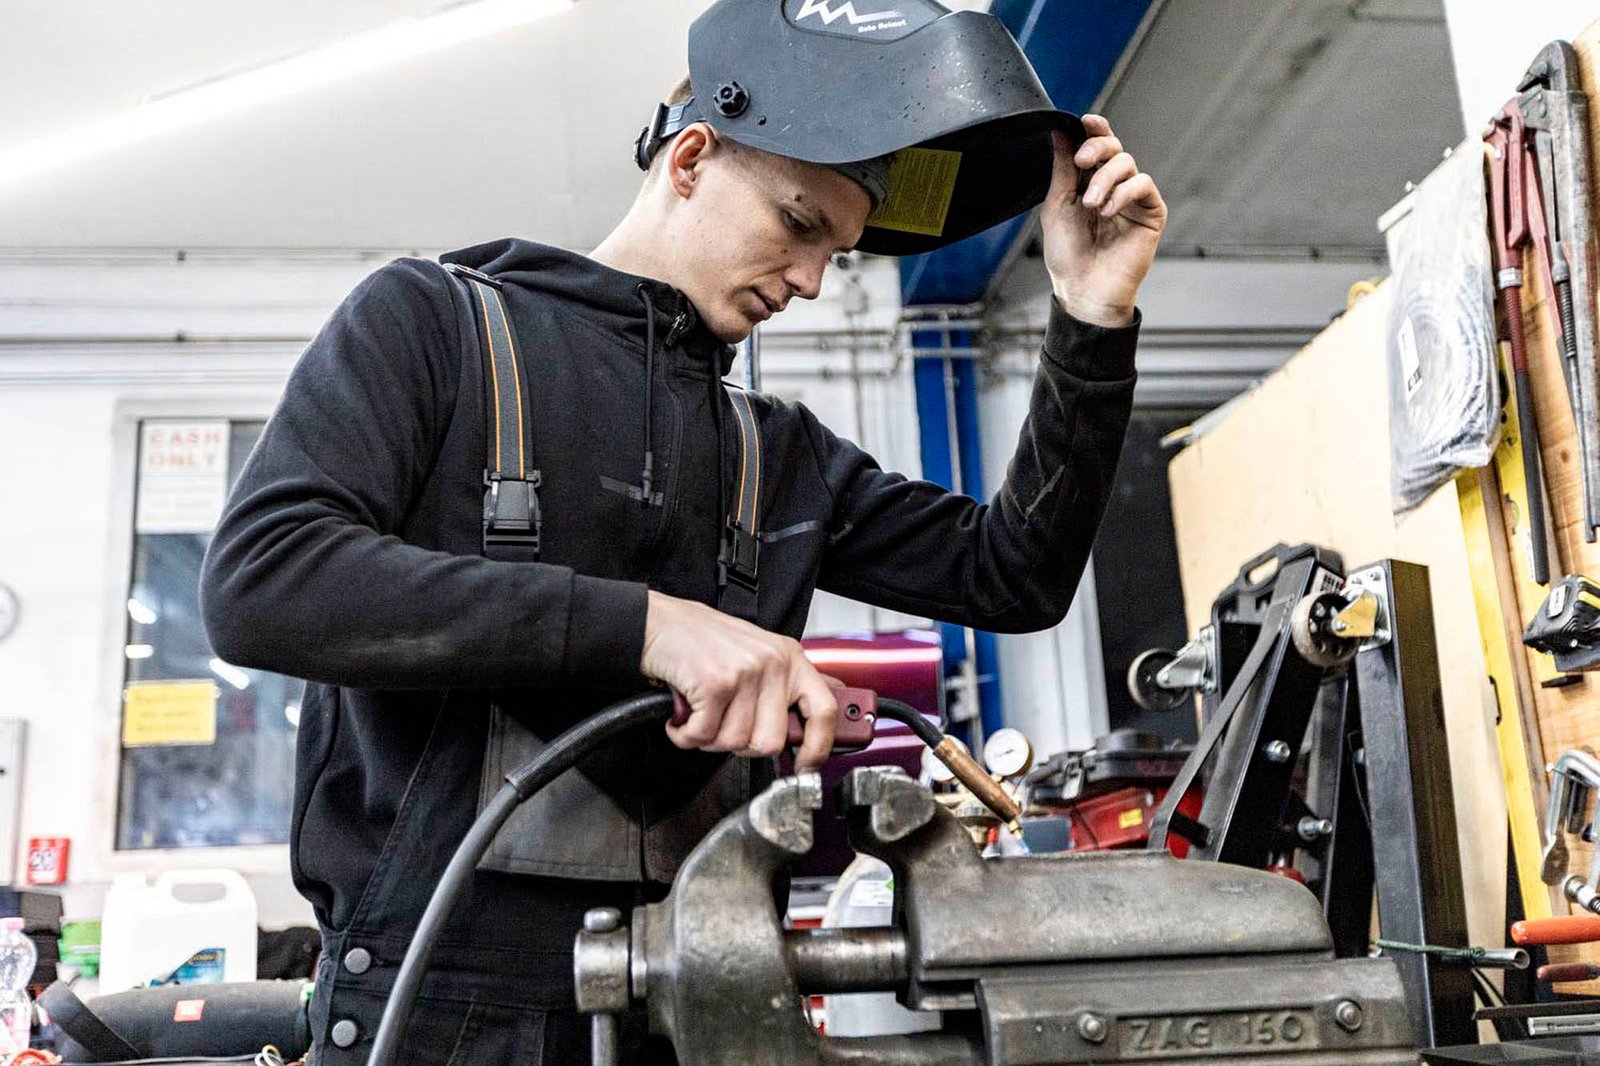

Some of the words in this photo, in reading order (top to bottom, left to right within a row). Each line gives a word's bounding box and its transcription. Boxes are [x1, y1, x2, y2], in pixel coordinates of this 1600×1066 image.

[149, 430, 220, 446] CASH
[149, 452, 216, 468] ONLY
[1130, 1018, 1213, 1050] ZAG
[1240, 1011, 1304, 1045] 150
